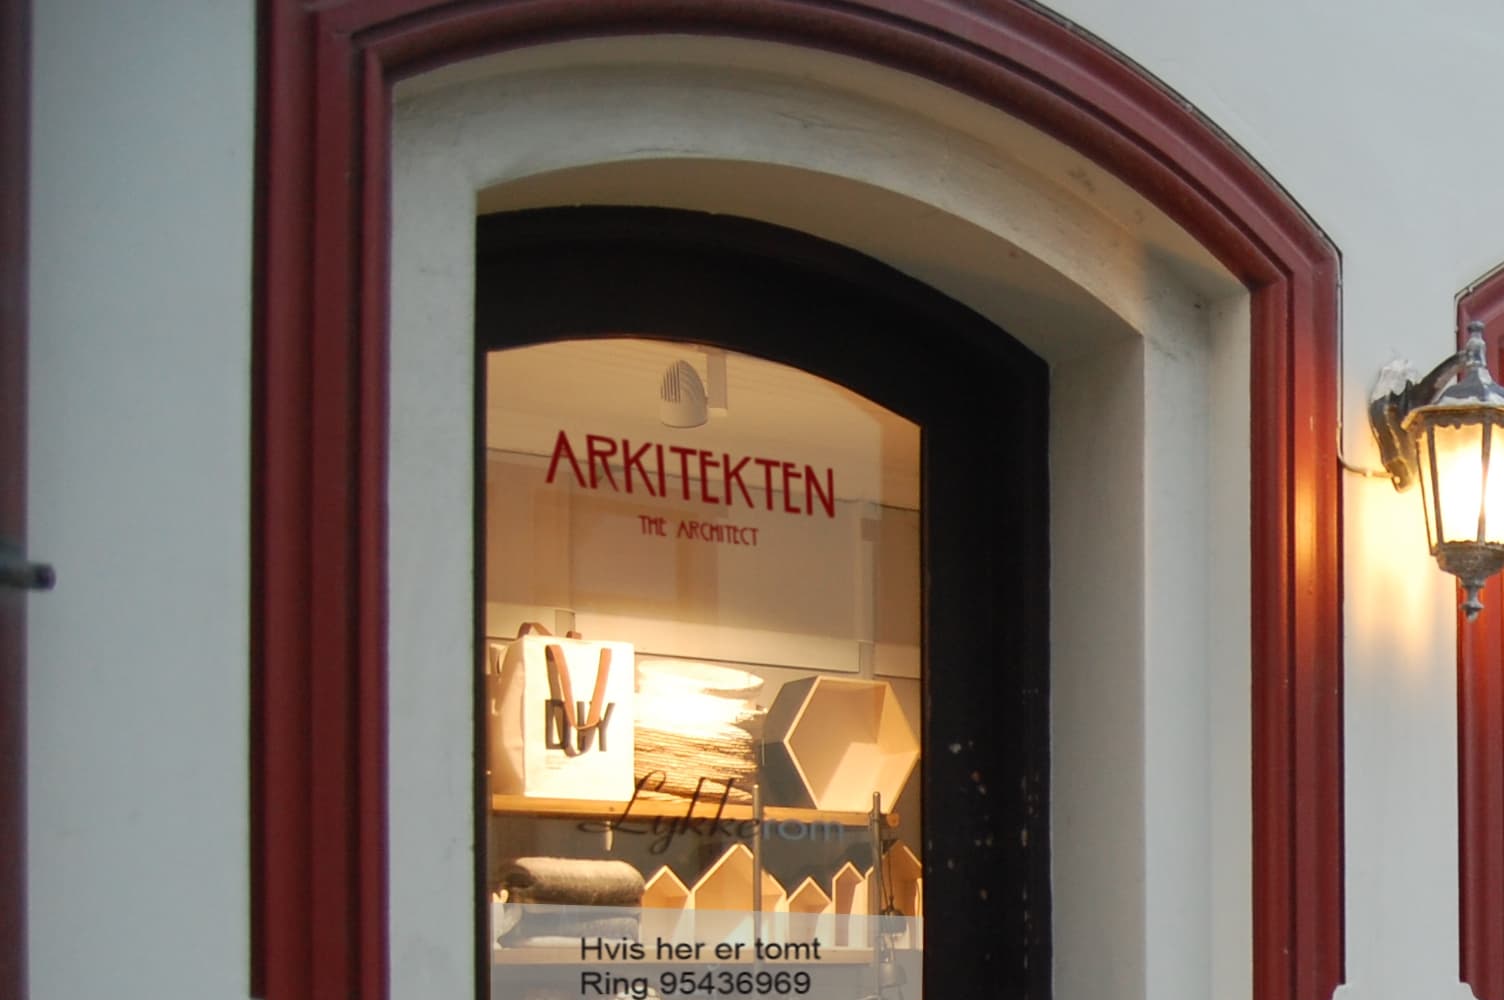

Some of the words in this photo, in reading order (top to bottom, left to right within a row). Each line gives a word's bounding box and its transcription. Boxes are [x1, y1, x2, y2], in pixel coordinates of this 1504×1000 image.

[545, 430, 836, 518] ARKITEKTEN
[638, 516, 667, 537] THE
[676, 520, 759, 547] ARCHITECT
[545, 699, 616, 752] DIY
[581, 937, 645, 961] Hvis
[656, 937, 706, 961] her
[715, 942, 747, 961] er
[754, 938, 822, 961] tomt
[581, 971, 649, 1000] Ring
[659, 971, 811, 995] 95436969
